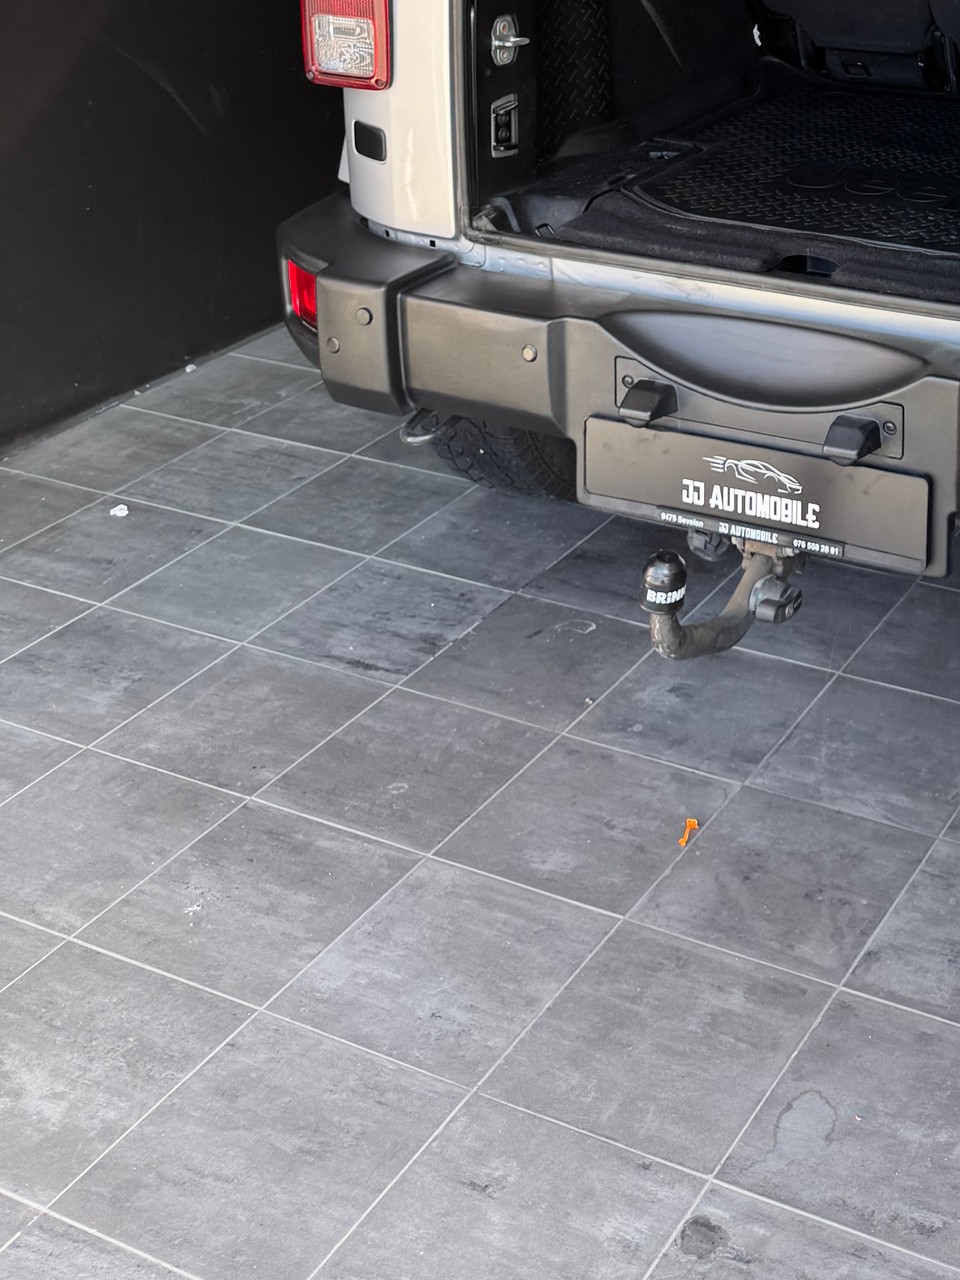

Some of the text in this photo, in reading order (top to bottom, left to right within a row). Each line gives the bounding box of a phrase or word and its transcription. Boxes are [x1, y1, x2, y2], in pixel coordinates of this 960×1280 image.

[682, 478, 820, 529] JJ AUTOMOBILE
[730, 524, 779, 544] AUTOMOBILE
